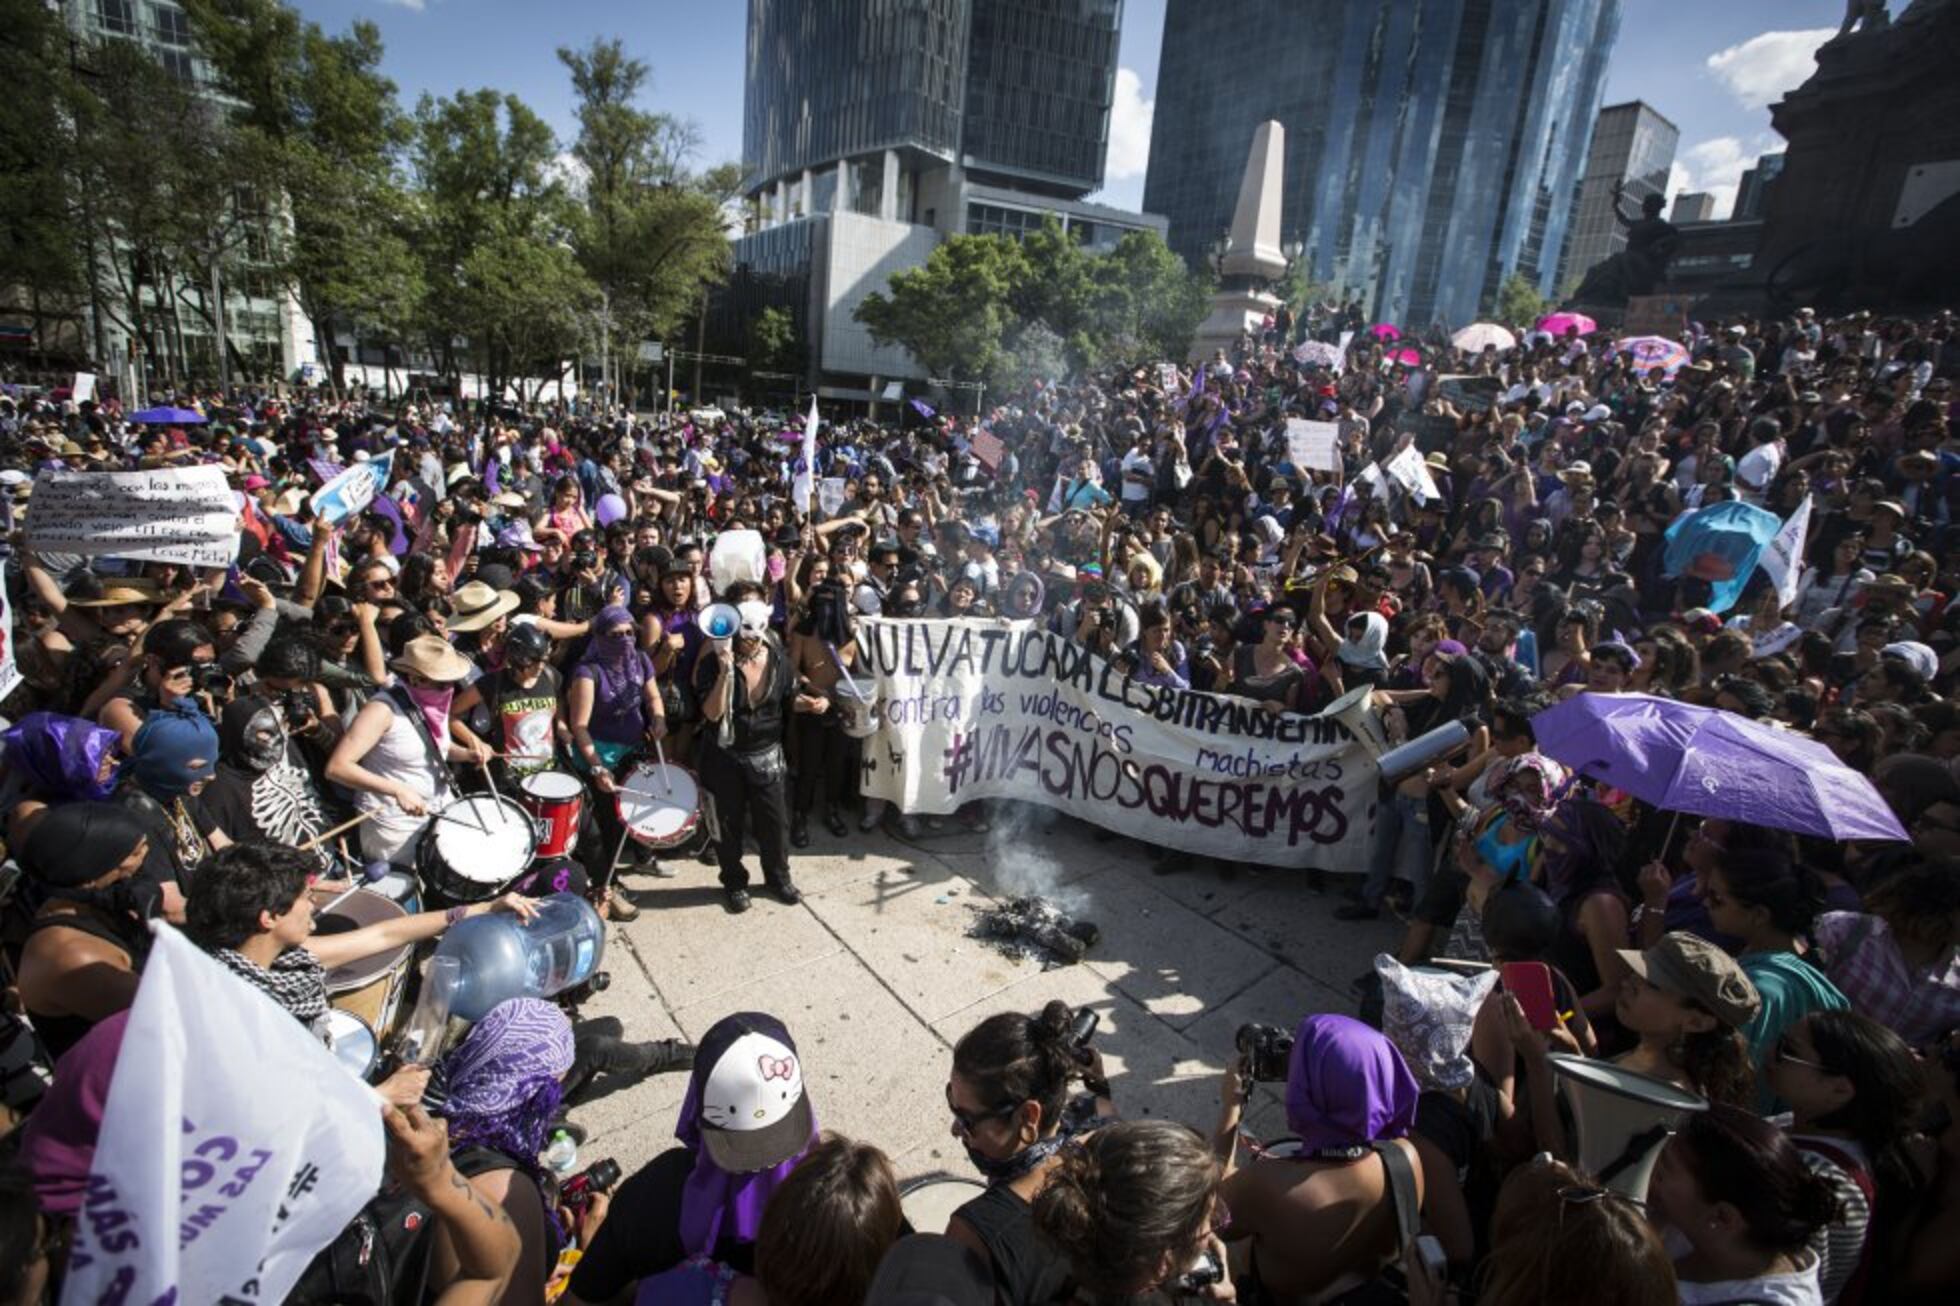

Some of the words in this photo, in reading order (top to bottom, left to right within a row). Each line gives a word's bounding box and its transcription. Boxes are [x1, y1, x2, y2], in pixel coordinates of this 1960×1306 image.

[148, 477, 170, 491] las
[882, 686, 960, 724] ontra
[1196, 748, 1344, 780] machistas
